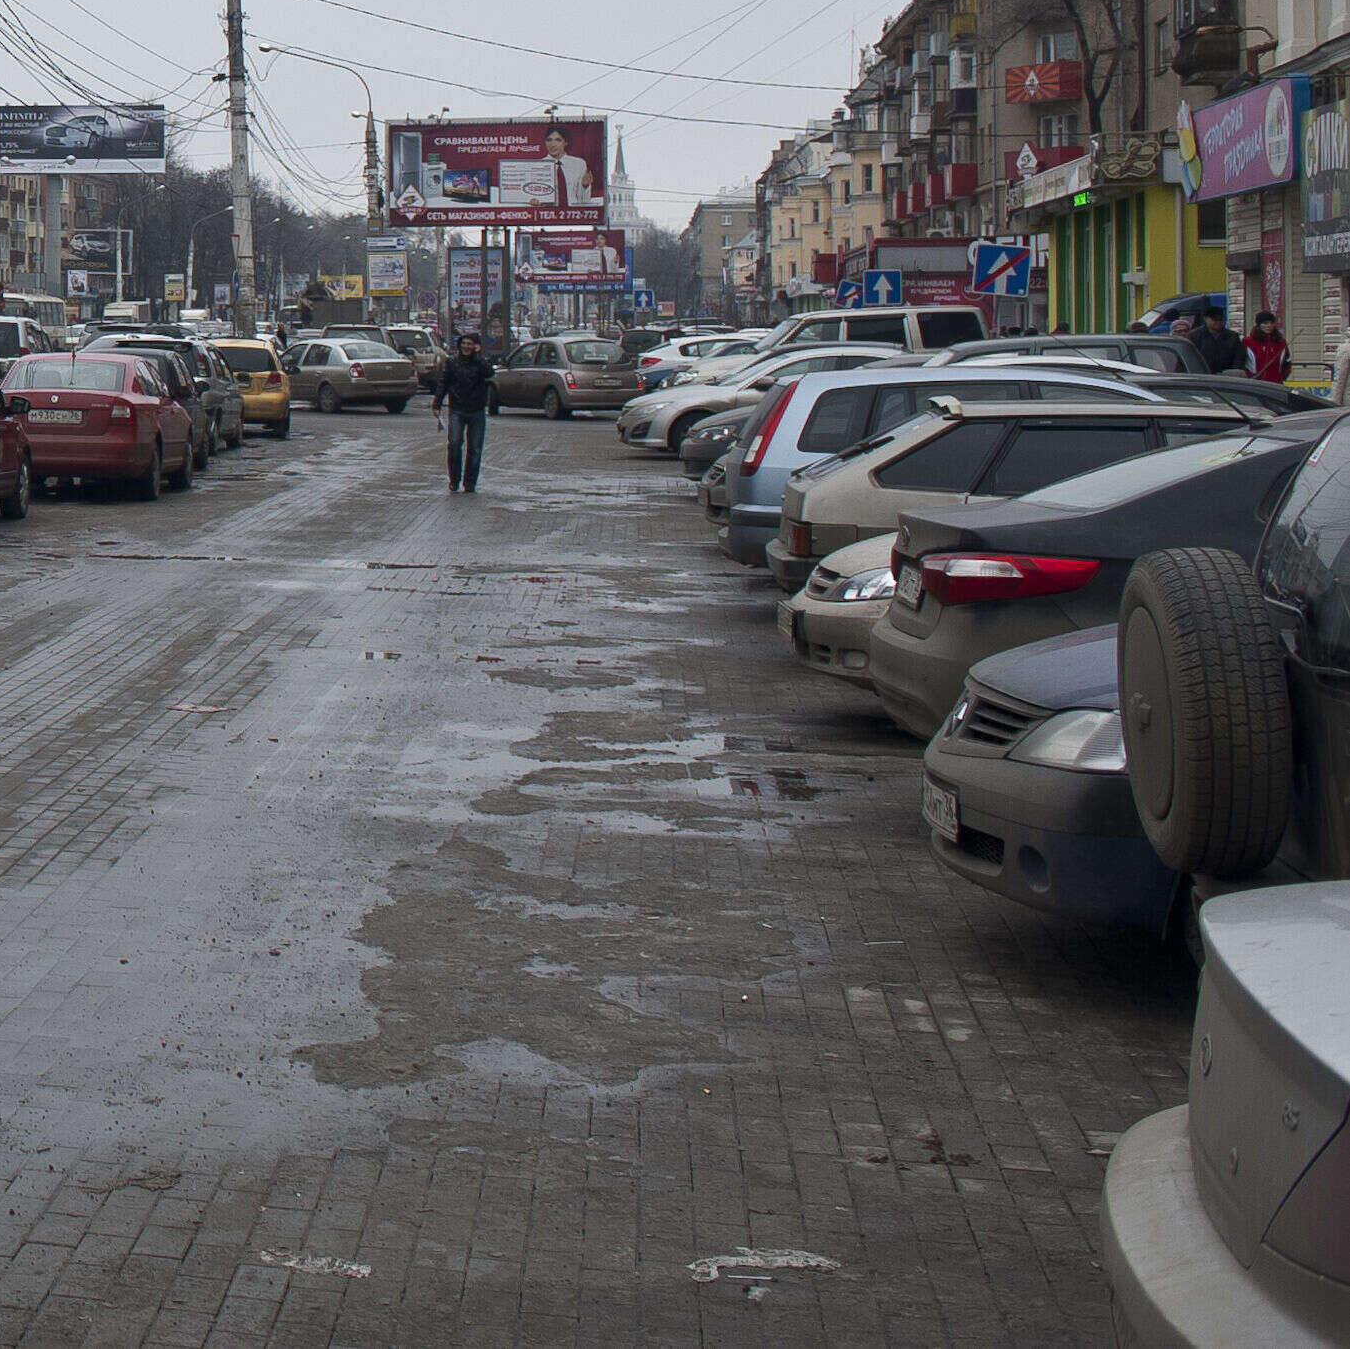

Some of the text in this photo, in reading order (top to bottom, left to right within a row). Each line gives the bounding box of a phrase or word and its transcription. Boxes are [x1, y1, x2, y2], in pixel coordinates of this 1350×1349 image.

[434, 136, 528, 146] СРАВНИВАЕМ ЦЕНЫ
[1305, 112, 1349, 179] СУМКИ
[427, 211, 447, 221] СЕТЬ
[448, 211, 496, 220] МАГАЗИНОВ
[539, 210, 557, 220] ТЕЛ.
[559, 210, 566, 219] 2
[566, 210, 599, 219] 772-772
